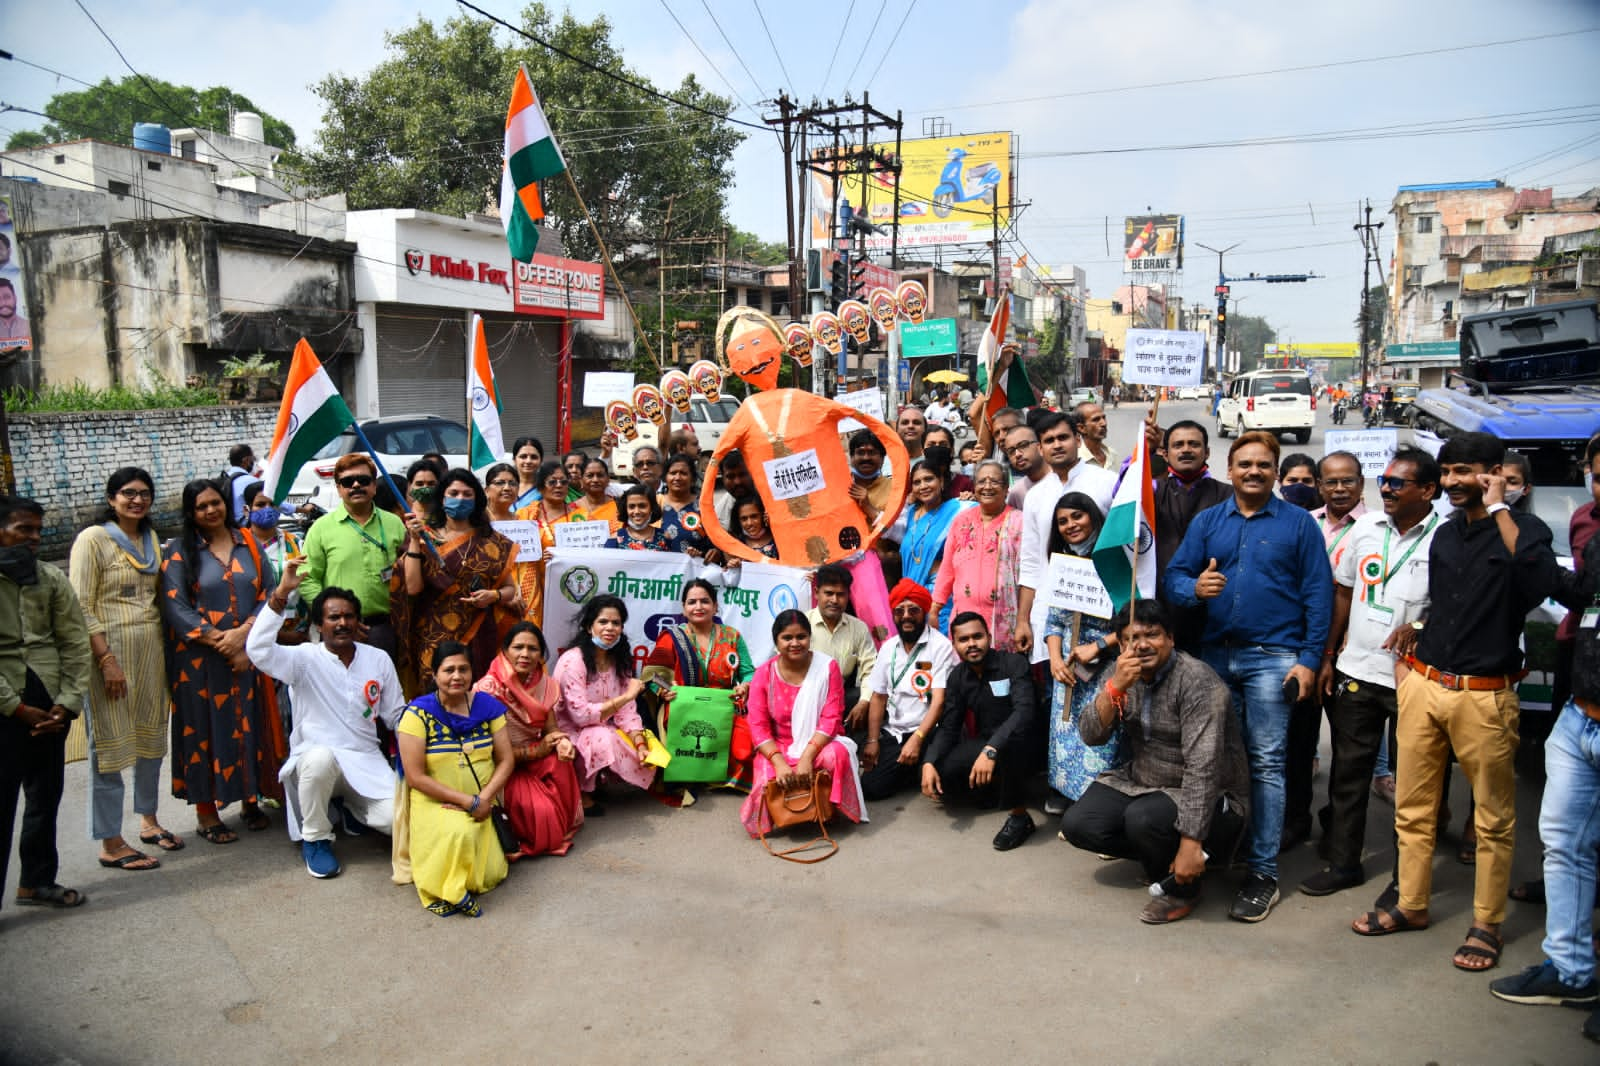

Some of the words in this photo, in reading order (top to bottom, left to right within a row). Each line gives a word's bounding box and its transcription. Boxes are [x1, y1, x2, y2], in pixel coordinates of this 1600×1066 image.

[430, 254, 475, 282] Klub
[478, 262, 510, 295] Fox
[517, 261, 566, 289] OFFER
[1132, 259, 1143, 270] BE
[1144, 257, 1170, 270] BRAVE
